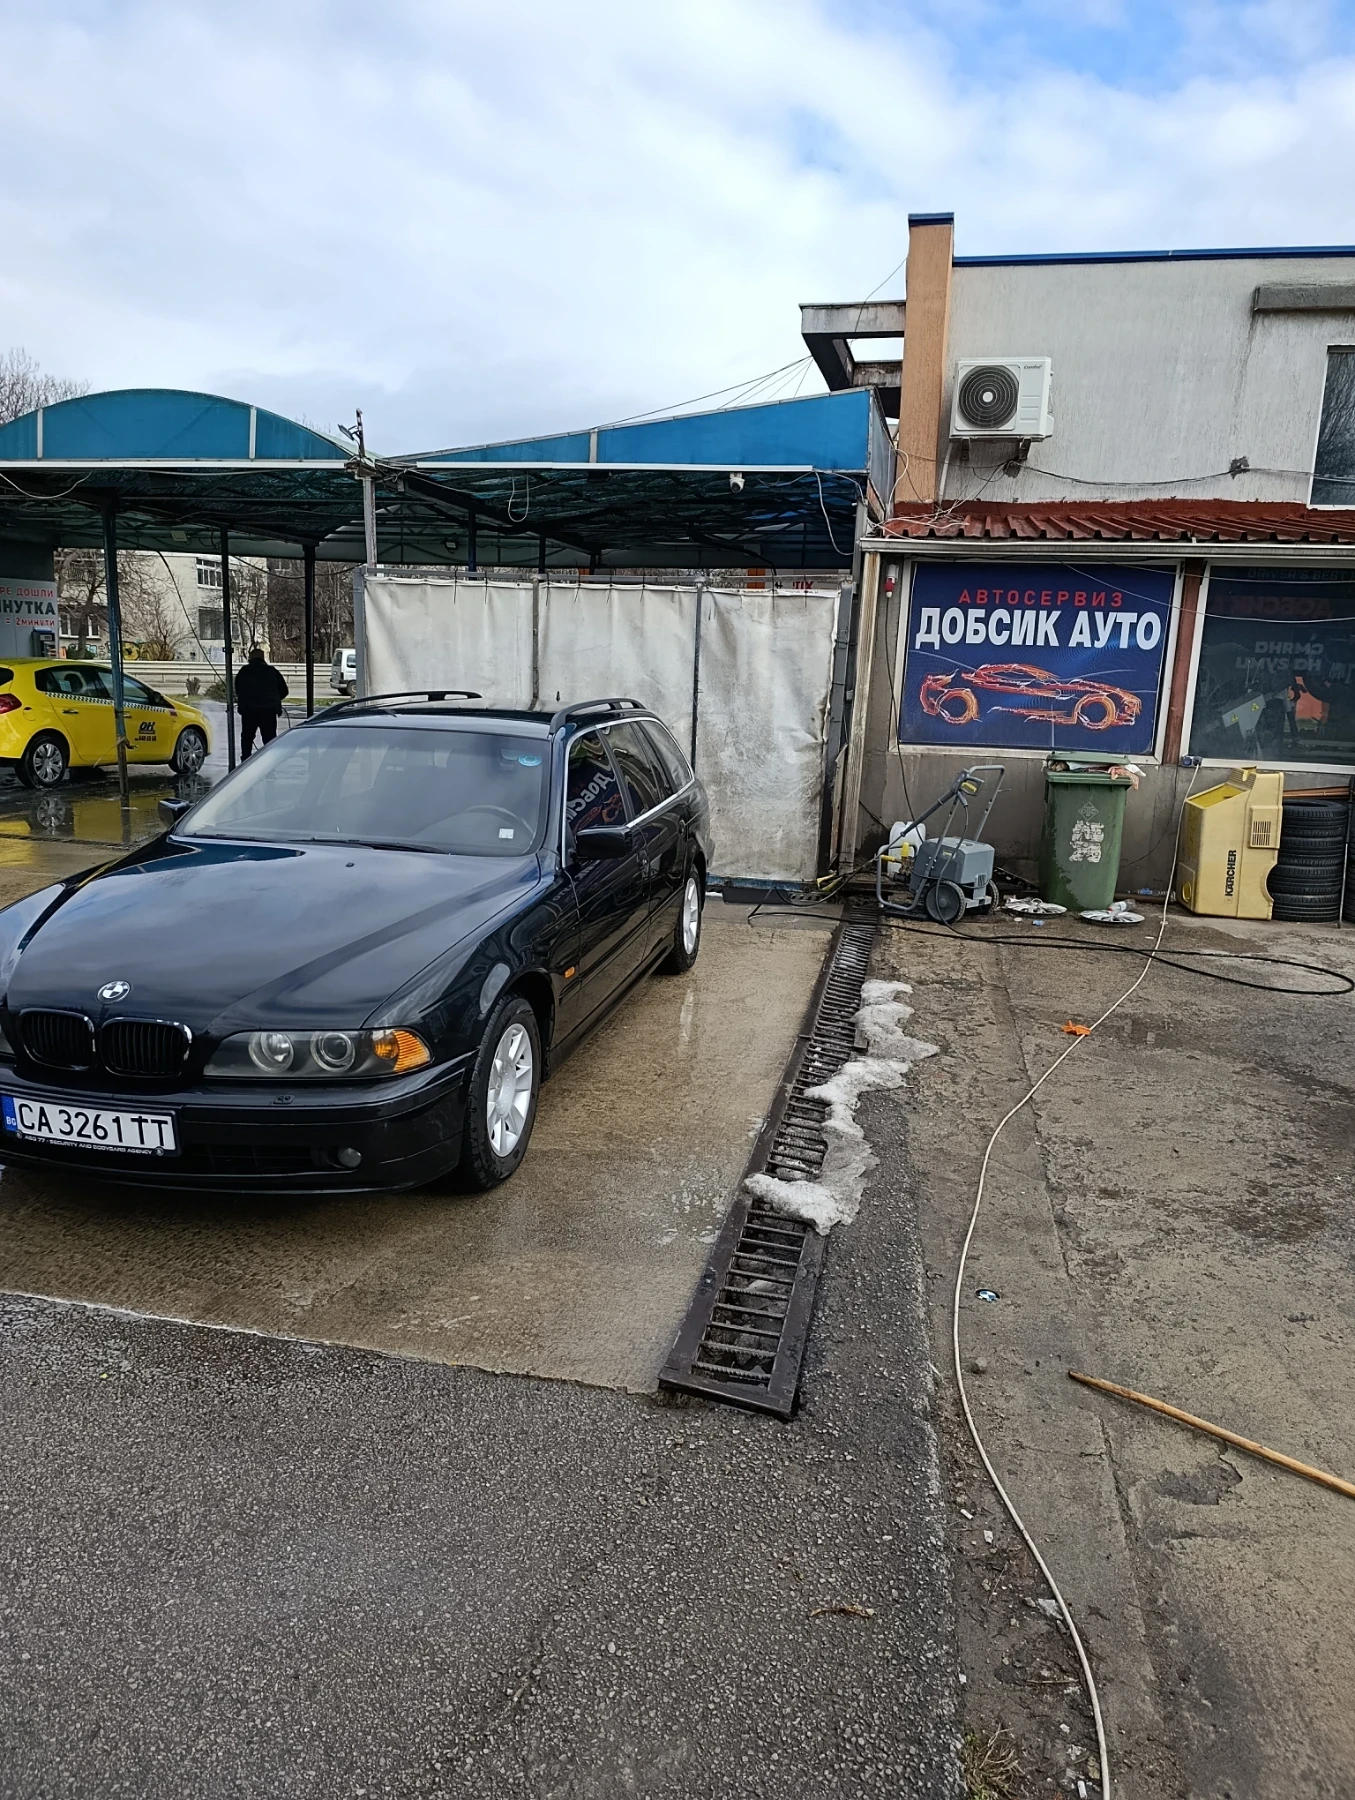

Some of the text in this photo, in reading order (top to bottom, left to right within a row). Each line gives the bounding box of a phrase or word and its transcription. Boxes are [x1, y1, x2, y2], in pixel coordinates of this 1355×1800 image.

[16, 588, 54, 598] ДОШЛИ
[958, 589, 1124, 608] АВТОСЕРВИЗ
[915, 606, 1162, 651] ДОБСИК АУТО
[6, 1116, 17, 1127] BG
[58, 1109, 124, 1143] 3261
[130, 1116, 168, 1147] TT
[126, 1149, 153, 1157] AGENCY
